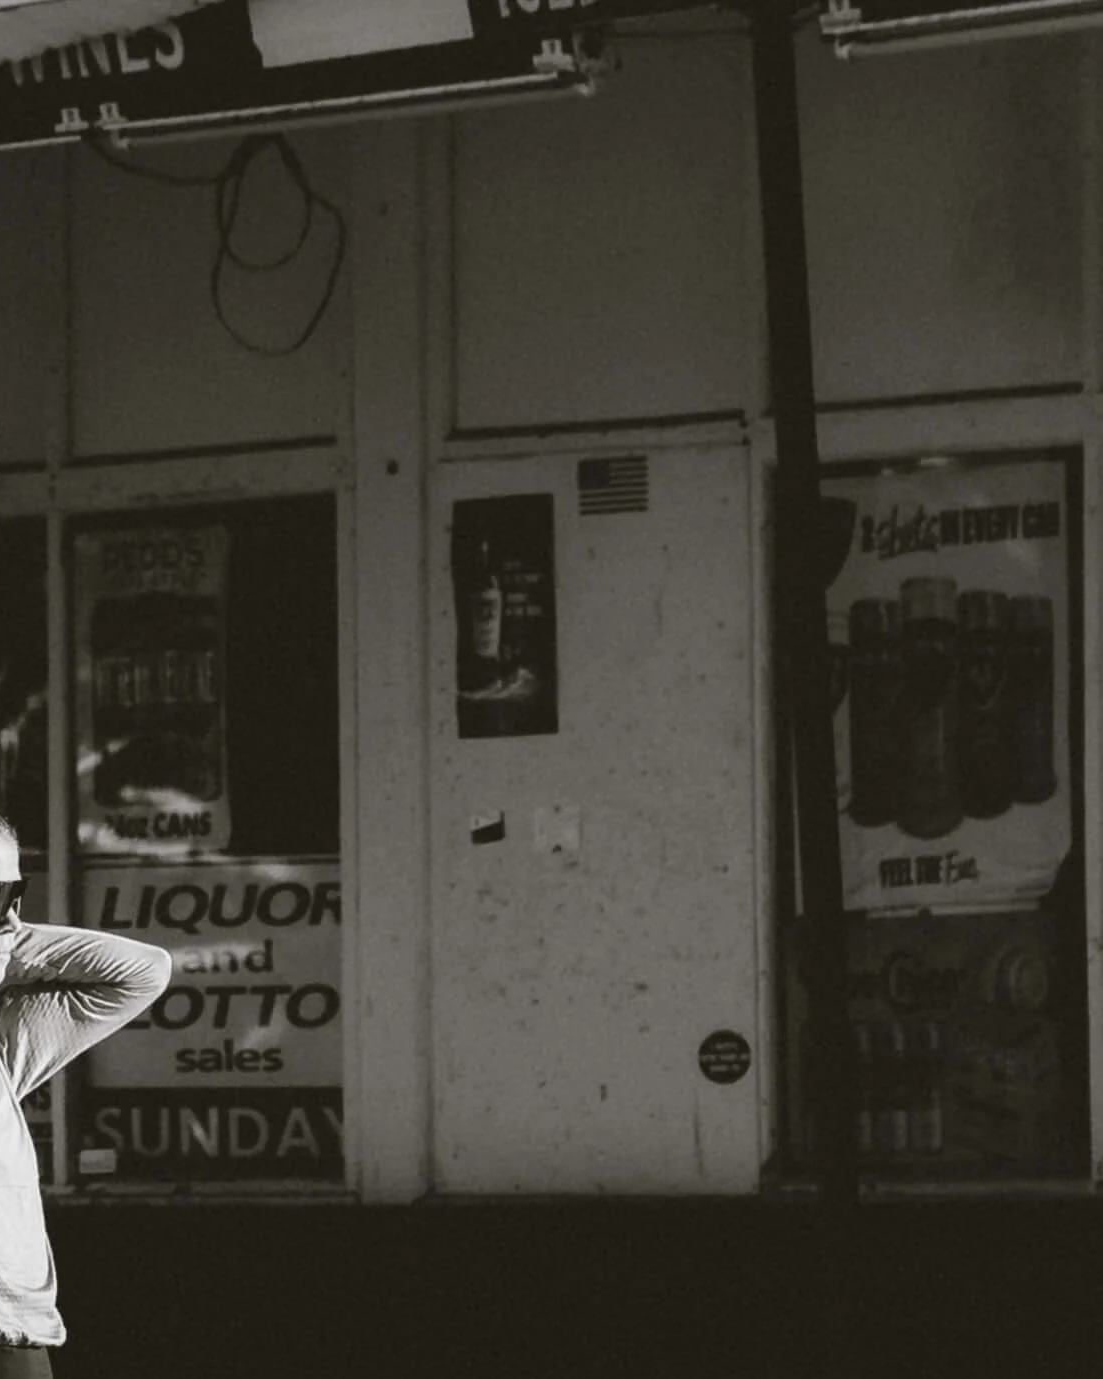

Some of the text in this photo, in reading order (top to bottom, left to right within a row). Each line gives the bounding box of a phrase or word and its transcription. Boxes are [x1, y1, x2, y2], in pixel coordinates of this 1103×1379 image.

[153, 811, 212, 838] CANS
[100, 882, 341, 934] LIQUOR
[181, 938, 274, 974] and
[176, 1039, 284, 1073] sales
